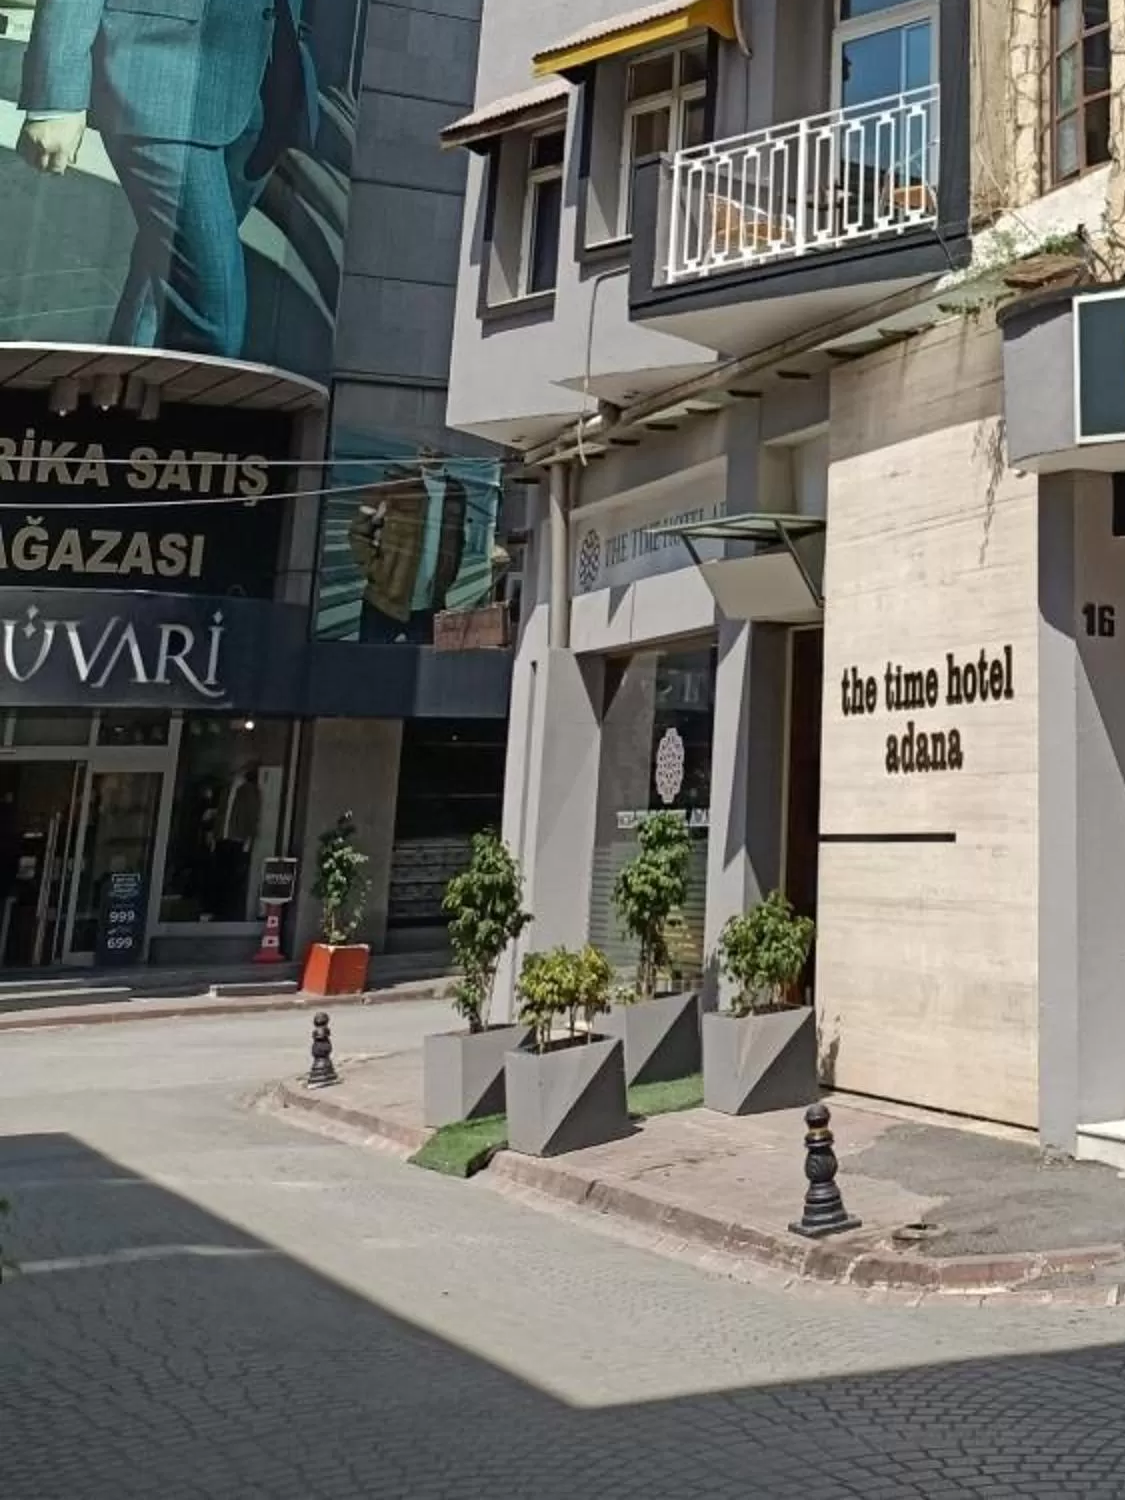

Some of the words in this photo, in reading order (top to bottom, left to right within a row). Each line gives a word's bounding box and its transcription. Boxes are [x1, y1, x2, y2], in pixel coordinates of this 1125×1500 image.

[126, 447, 269, 507] SATIŞ
[0, 515, 205, 578] ĞAZASI
[1082, 603, 1116, 637] 16
[841, 666, 877, 716] the
[884, 661, 939, 711] time
[945, 644, 1014, 704] hotel
[885, 721, 964, 774] adana
